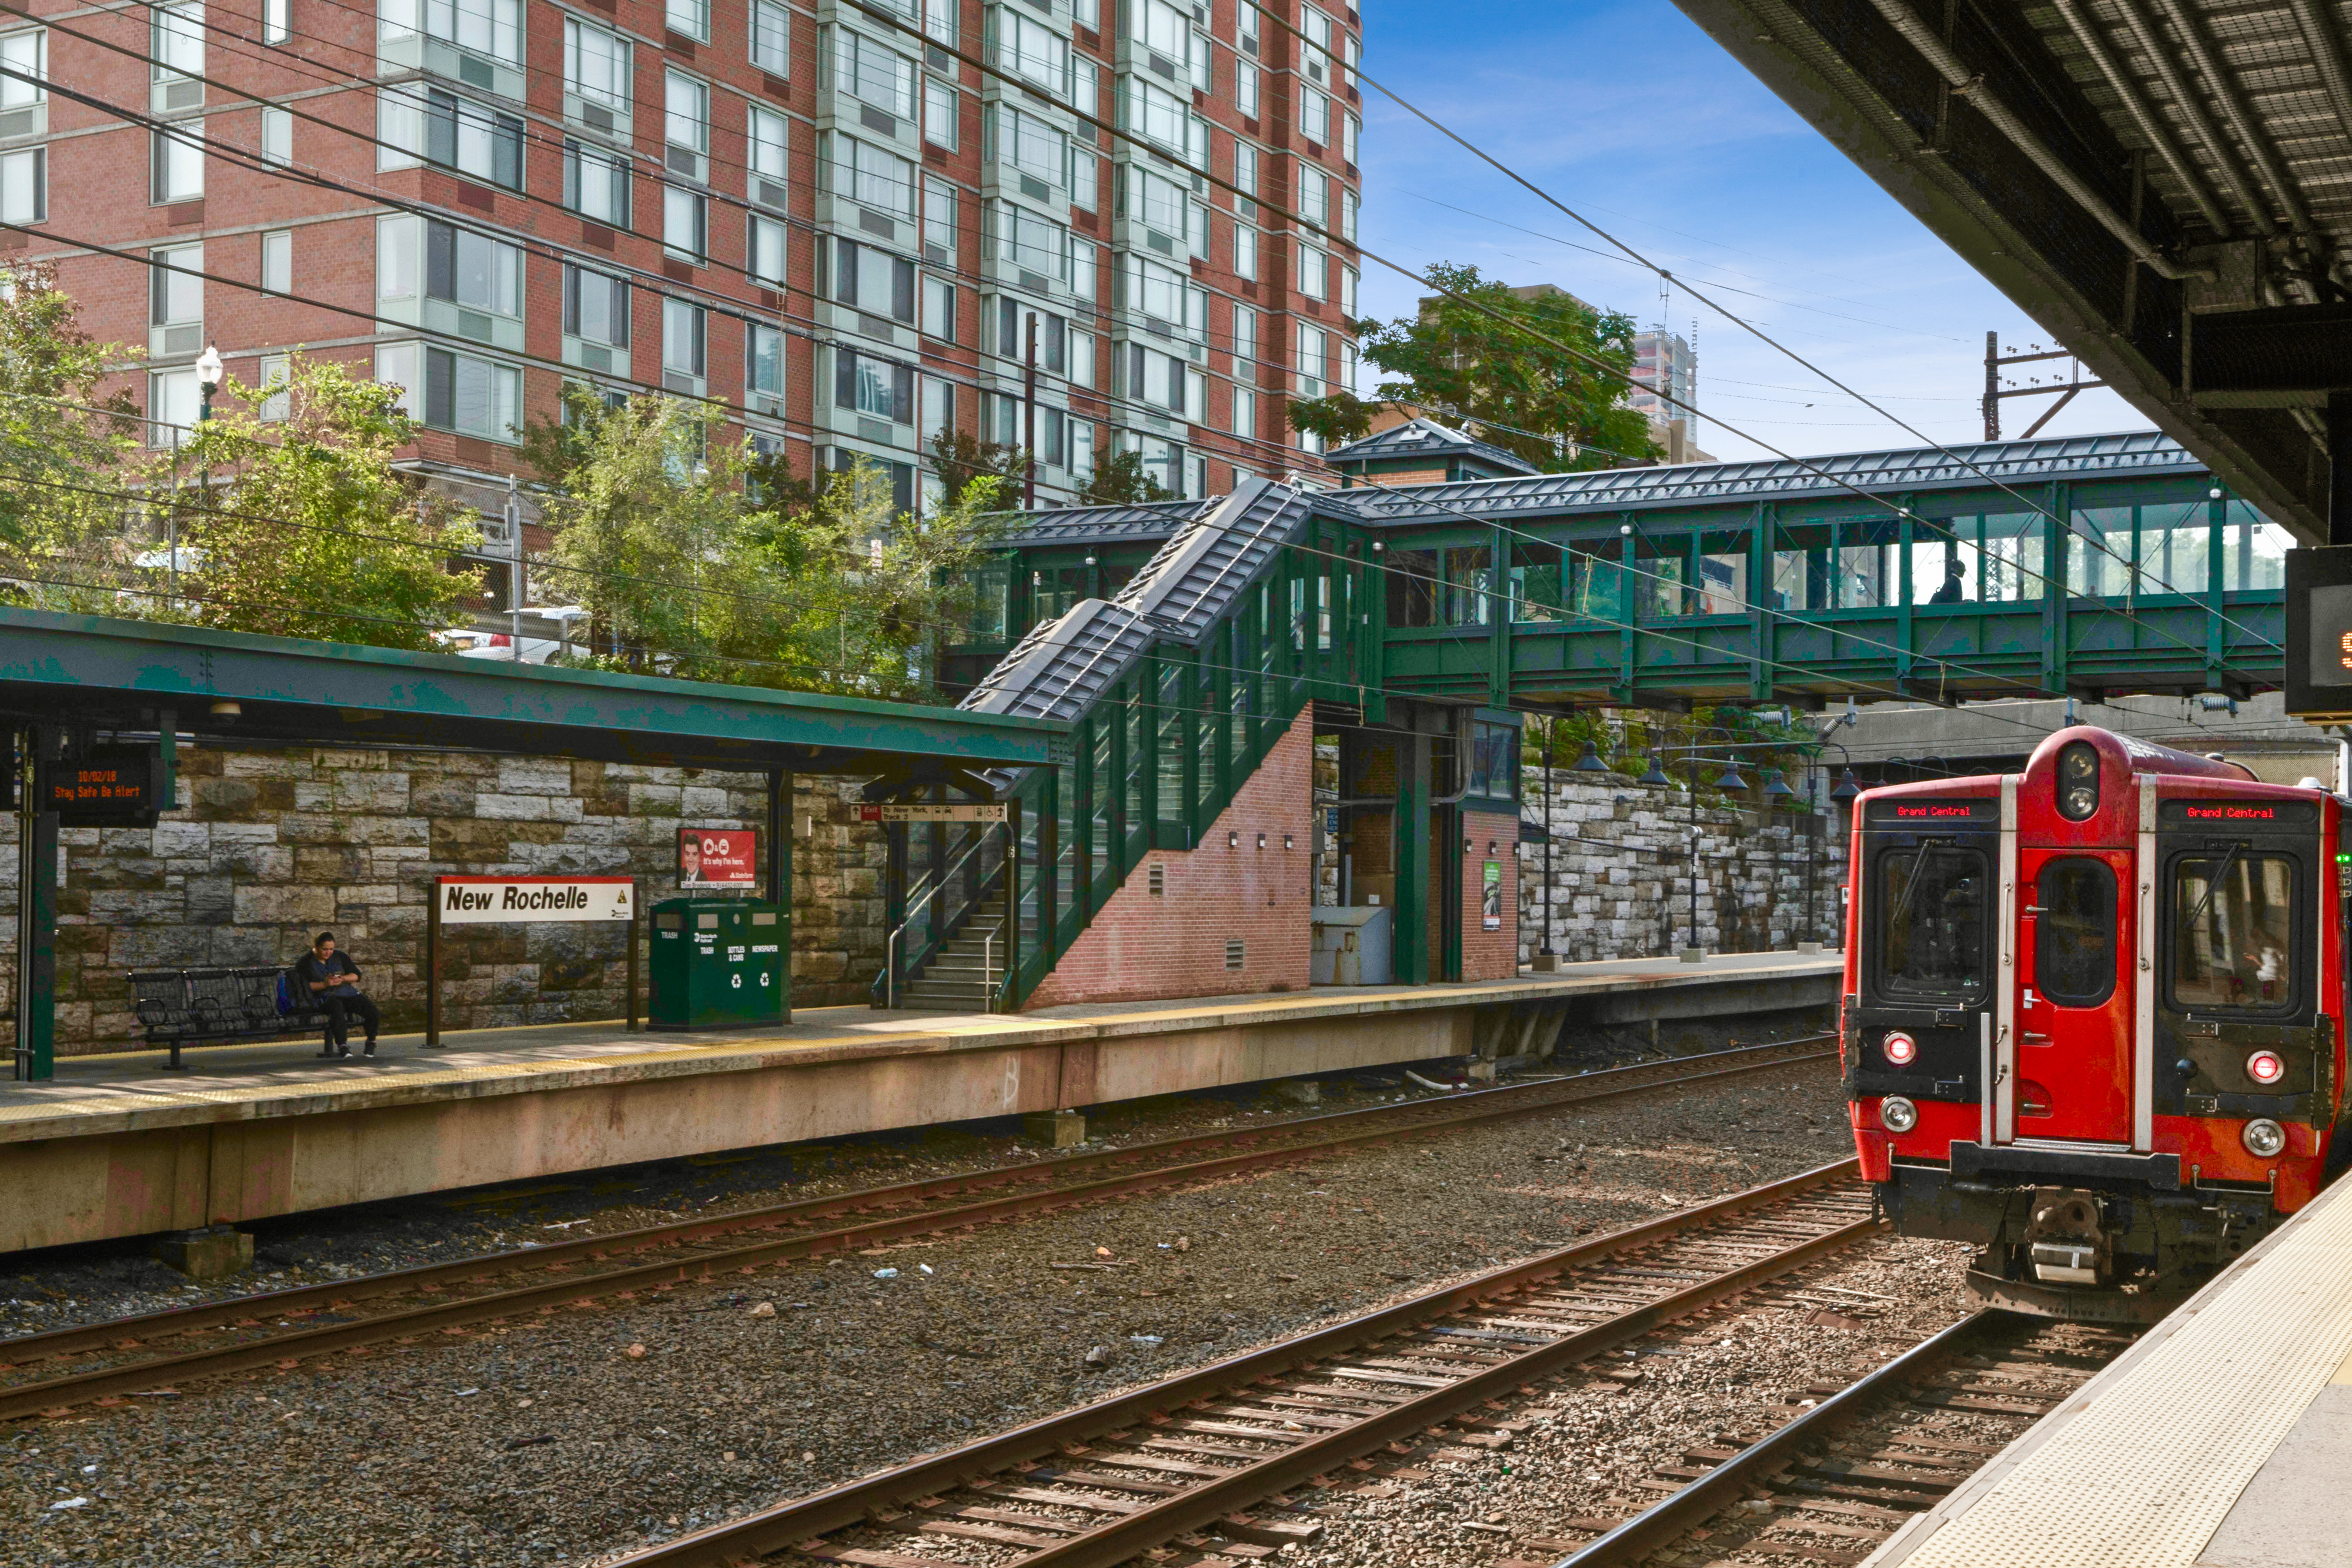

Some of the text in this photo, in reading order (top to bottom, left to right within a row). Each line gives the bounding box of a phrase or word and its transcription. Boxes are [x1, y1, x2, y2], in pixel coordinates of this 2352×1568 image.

[78, 770, 116, 783] 10/02/18
[55, 785, 140, 801] Stay Safe Be Alert
[1897, 806, 1970, 816] Grand Central
[2187, 807, 2274, 818] Grand Central
[712, 858, 722, 867] why
[446, 885, 588, 911] New Rochelle
[661, 931, 678, 940] TRASH
[700, 947, 714, 955] TRASH
[727, 945, 745, 954] BOTTLES
[752, 945, 779, 953] NEWSPAPER
[733, 954, 744, 962] CANS
